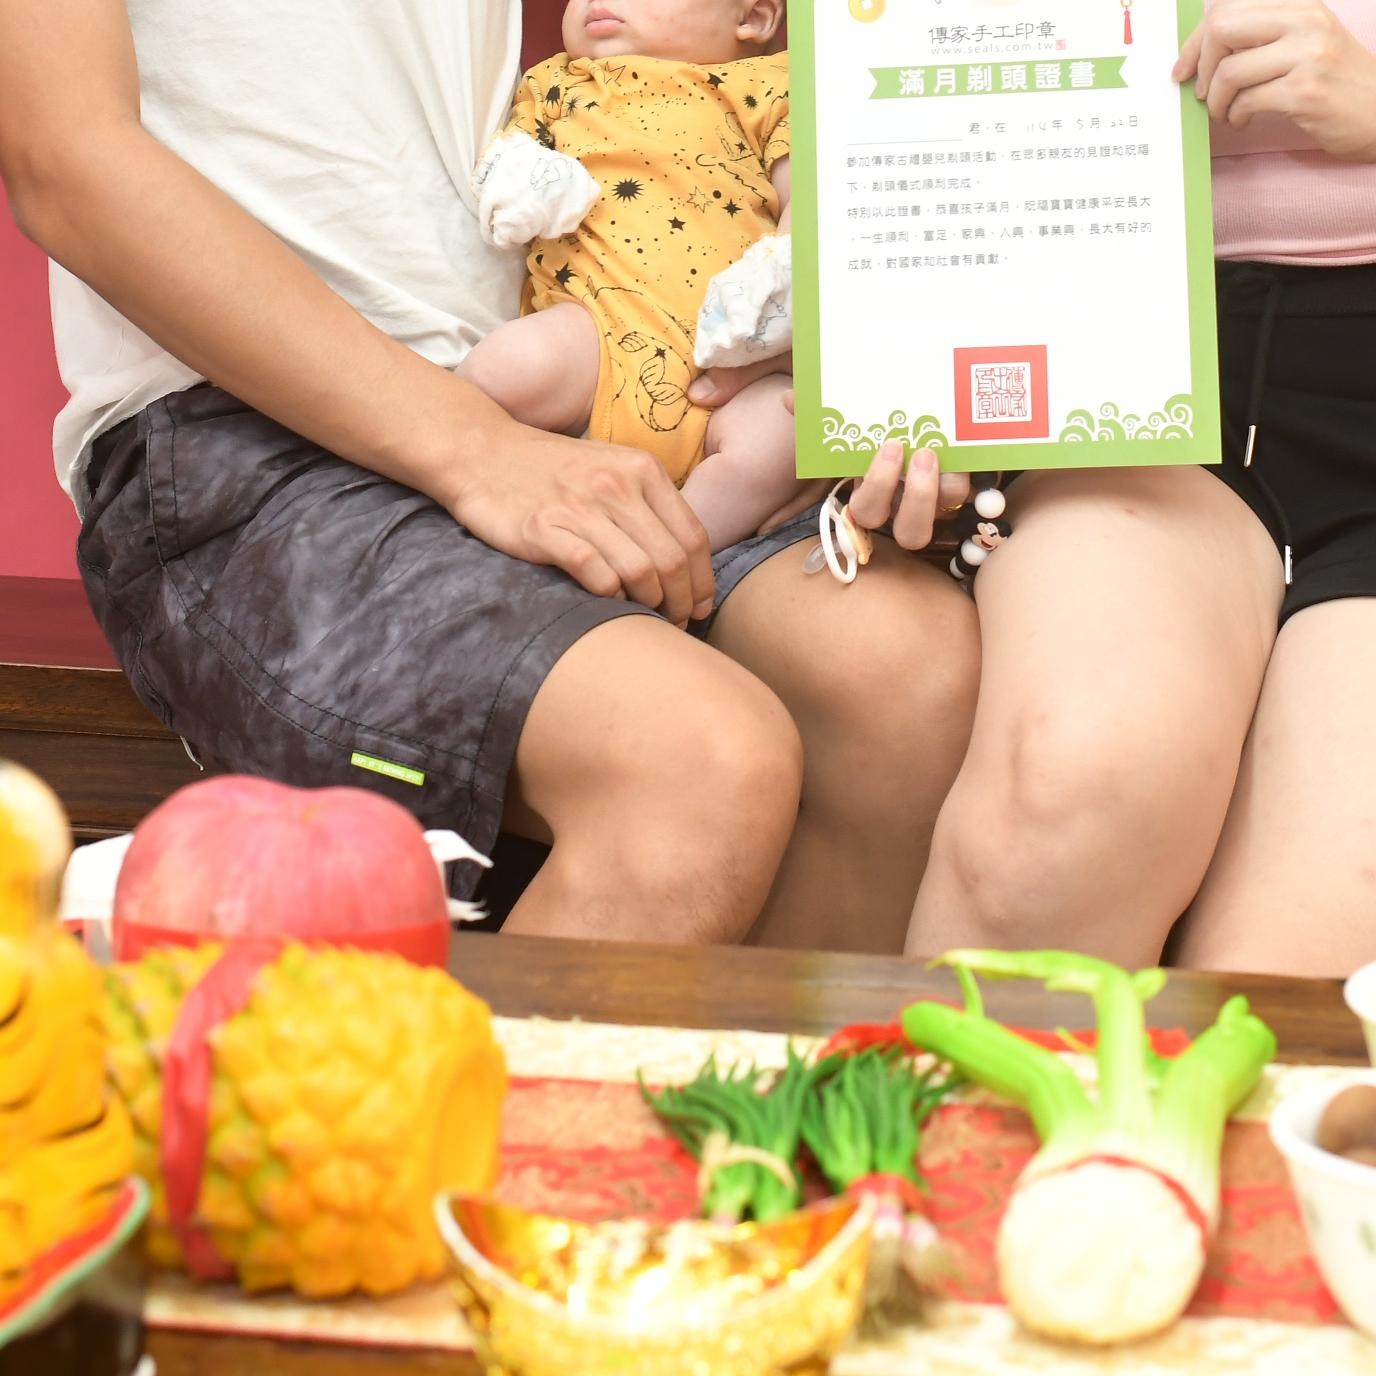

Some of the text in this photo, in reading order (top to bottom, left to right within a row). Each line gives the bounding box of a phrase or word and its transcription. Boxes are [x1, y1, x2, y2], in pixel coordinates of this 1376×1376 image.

[928, 21, 1056, 44] 傳家手工印章
[930, 41, 1054, 55] www.seals.com.tw
[899, 61, 1096, 95] 滿月剃頭證書
